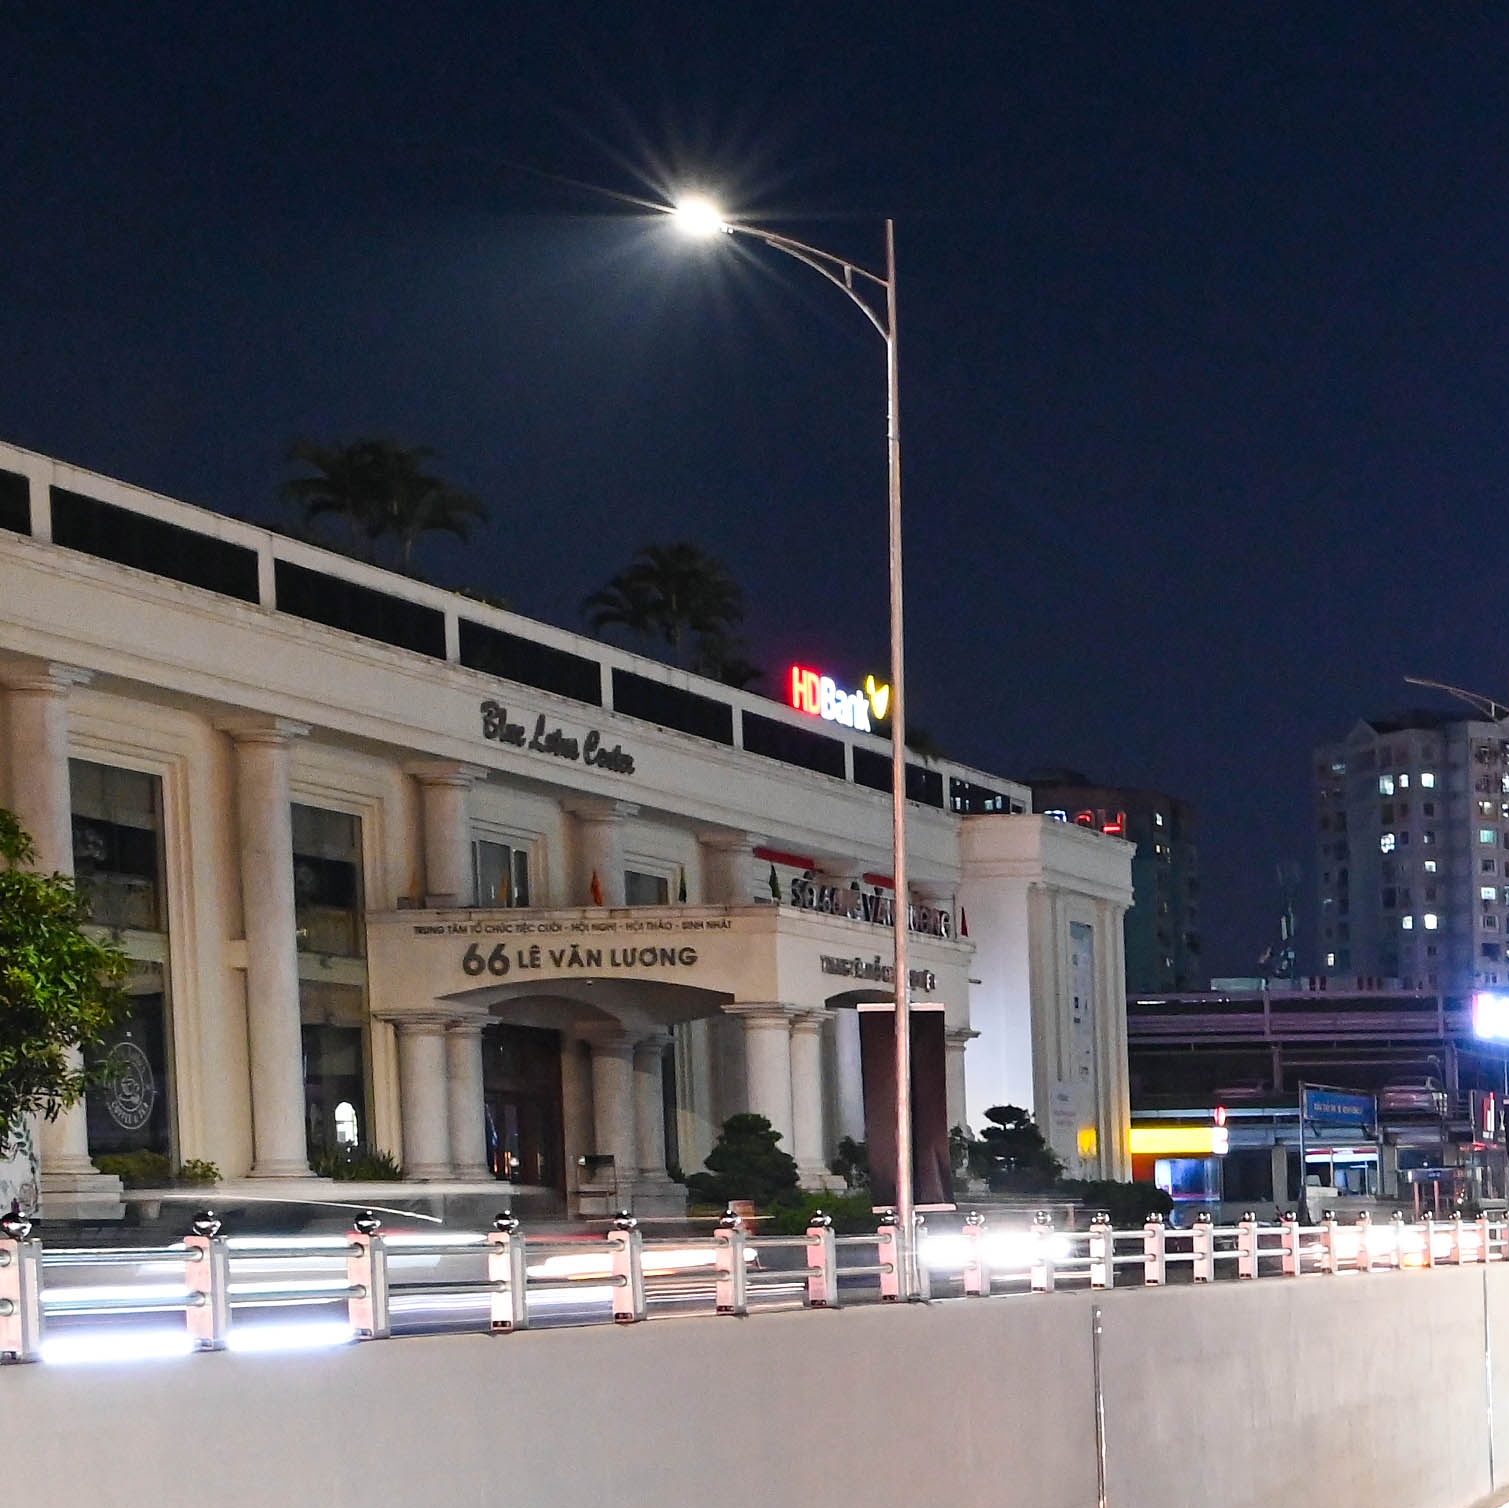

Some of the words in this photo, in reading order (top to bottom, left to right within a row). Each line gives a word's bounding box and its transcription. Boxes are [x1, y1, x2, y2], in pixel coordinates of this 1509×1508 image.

[791, 664, 871, 733] HDBank
[480, 700, 526, 747] Blue
[529, 713, 580, 760] Lotus
[583, 730, 635, 775] Center
[462, 943, 511, 976] 66
[518, 944, 541, 968] LÊ
[549, 944, 602, 968] VĂN
[610, 946, 698, 967] LƯƠNG
